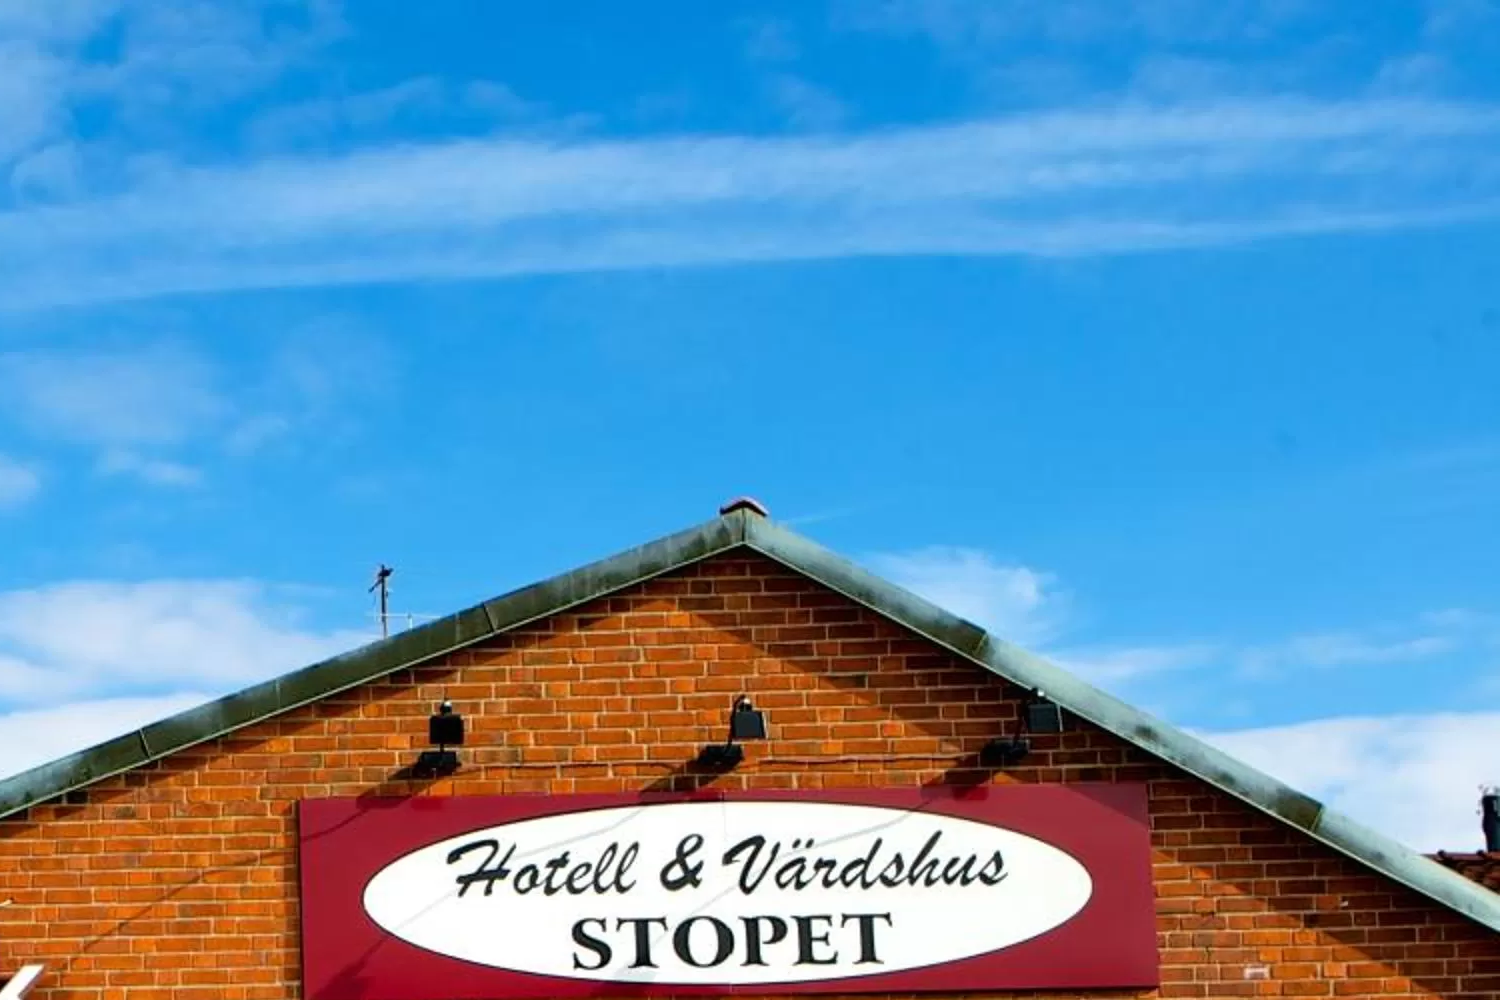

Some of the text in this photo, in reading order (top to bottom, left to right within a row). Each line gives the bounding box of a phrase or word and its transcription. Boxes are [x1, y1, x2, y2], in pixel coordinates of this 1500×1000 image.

[445, 830, 1009, 898] Hotell & Värdshus
[571, 912, 893, 970] STOPET
